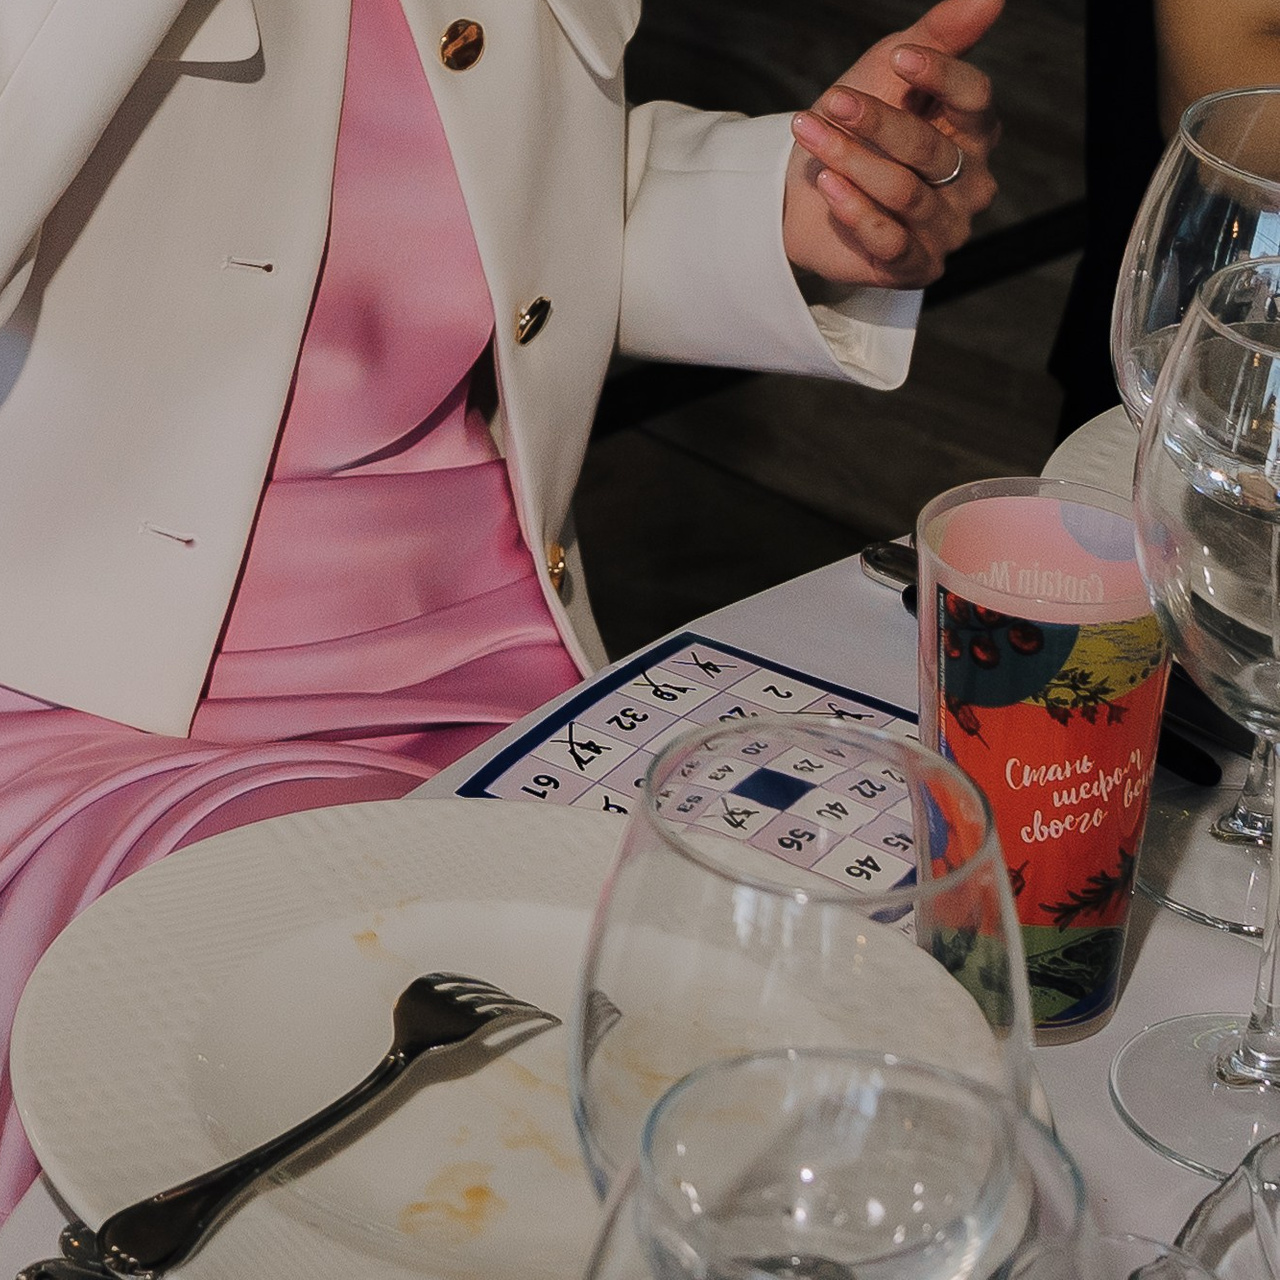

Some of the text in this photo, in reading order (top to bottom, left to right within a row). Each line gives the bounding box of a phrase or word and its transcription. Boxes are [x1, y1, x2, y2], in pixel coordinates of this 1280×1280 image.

[762, 684, 793, 699] 2
[605, 707, 649, 732] 32
[741, 741, 768, 756] 20
[1005, 754, 1095, 790] Стань
[1053, 748, 1143, 808] шефом
[521, 774, 560, 800] 61
[848, 778, 887, 800] 22
[1020, 807, 1108, 844] своего
[777, 828, 817, 852] 56
[845, 854, 882, 882] 46
